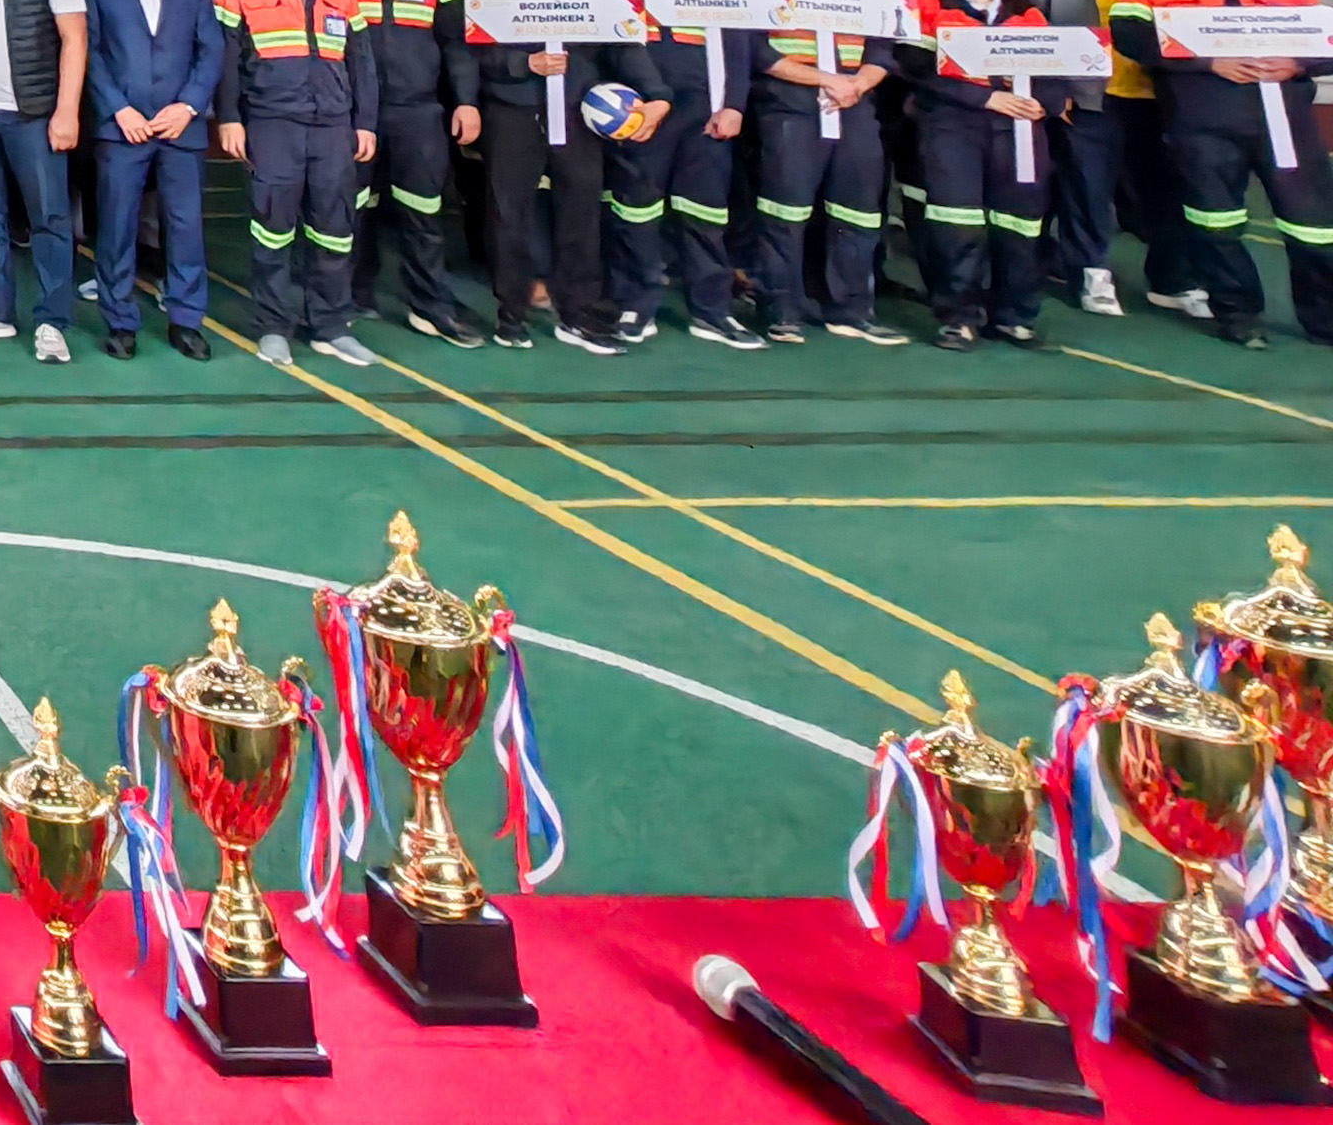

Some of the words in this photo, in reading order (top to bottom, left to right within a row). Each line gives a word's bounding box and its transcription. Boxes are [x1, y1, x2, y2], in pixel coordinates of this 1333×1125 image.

[519, 0, 590, 10] ВОЛЕЙБОЛ
[511, 14, 585, 23] АЛТЫНКЕН
[985, 34, 1060, 43] БАДМИНТОН
